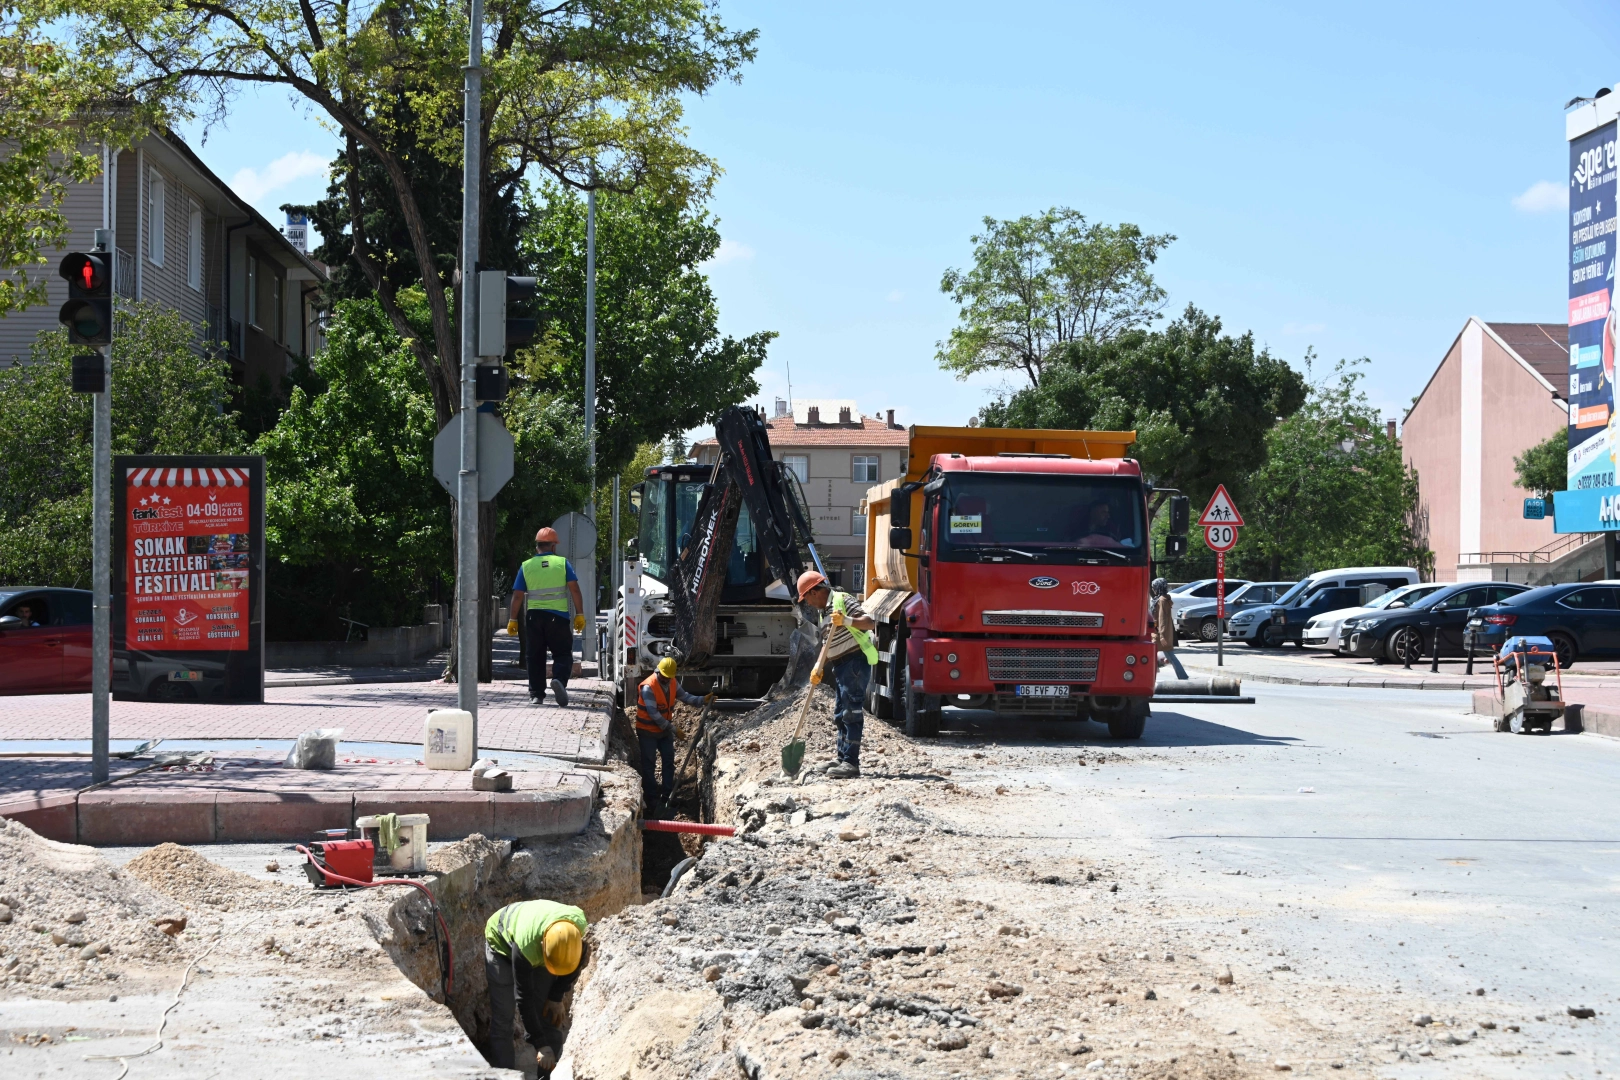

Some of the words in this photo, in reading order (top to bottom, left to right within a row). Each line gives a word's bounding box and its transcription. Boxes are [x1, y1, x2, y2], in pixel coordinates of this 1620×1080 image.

[187, 503, 218, 517] 04-09
[222, 508, 243, 516] 2026
[1211, 528, 1232, 542] 30
[134, 536, 185, 556] SOKAK
[1021, 686, 1030, 695] 06
[1054, 686, 1069, 695] 762
